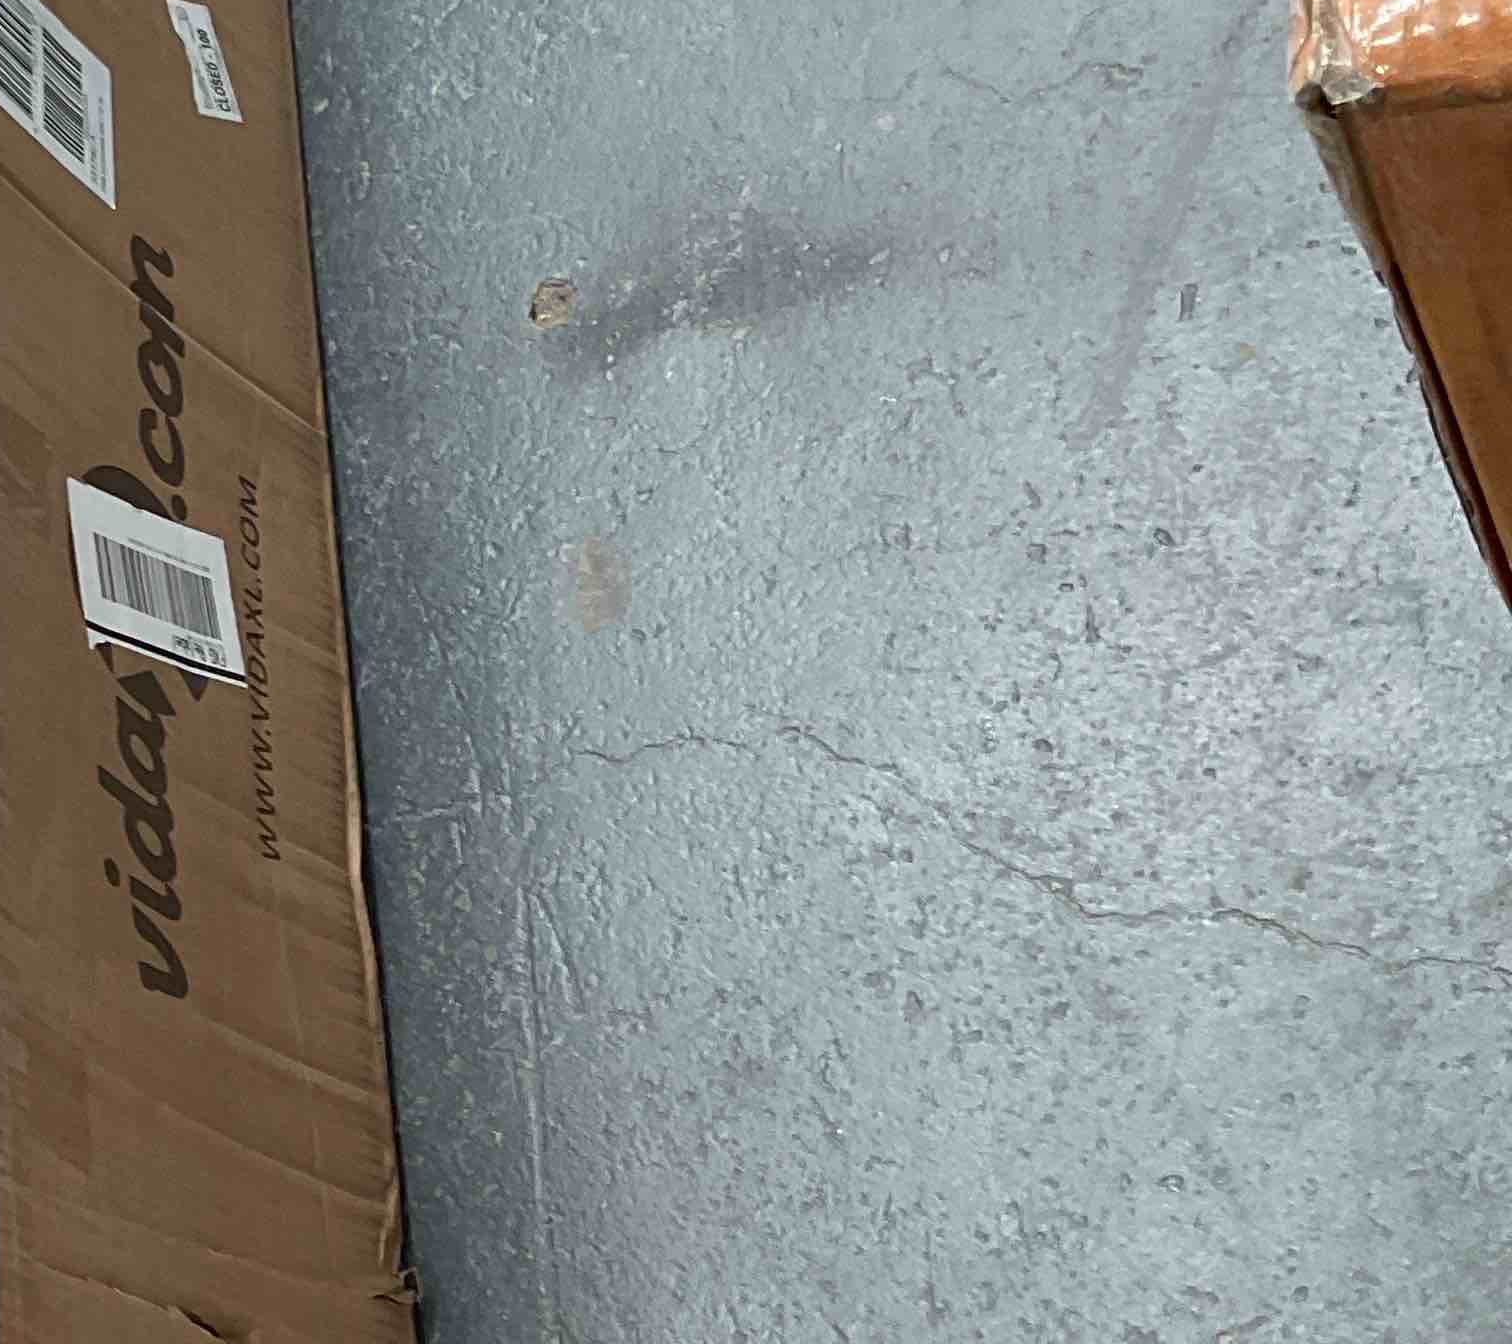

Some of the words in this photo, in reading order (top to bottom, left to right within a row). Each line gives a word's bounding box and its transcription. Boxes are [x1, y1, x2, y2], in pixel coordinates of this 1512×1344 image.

[207, 61, 232, 113] CLOSED
[82, 232, 208, 1000] vida.com
[238, 473, 281, 862] WWW.VIDAXL.COM
